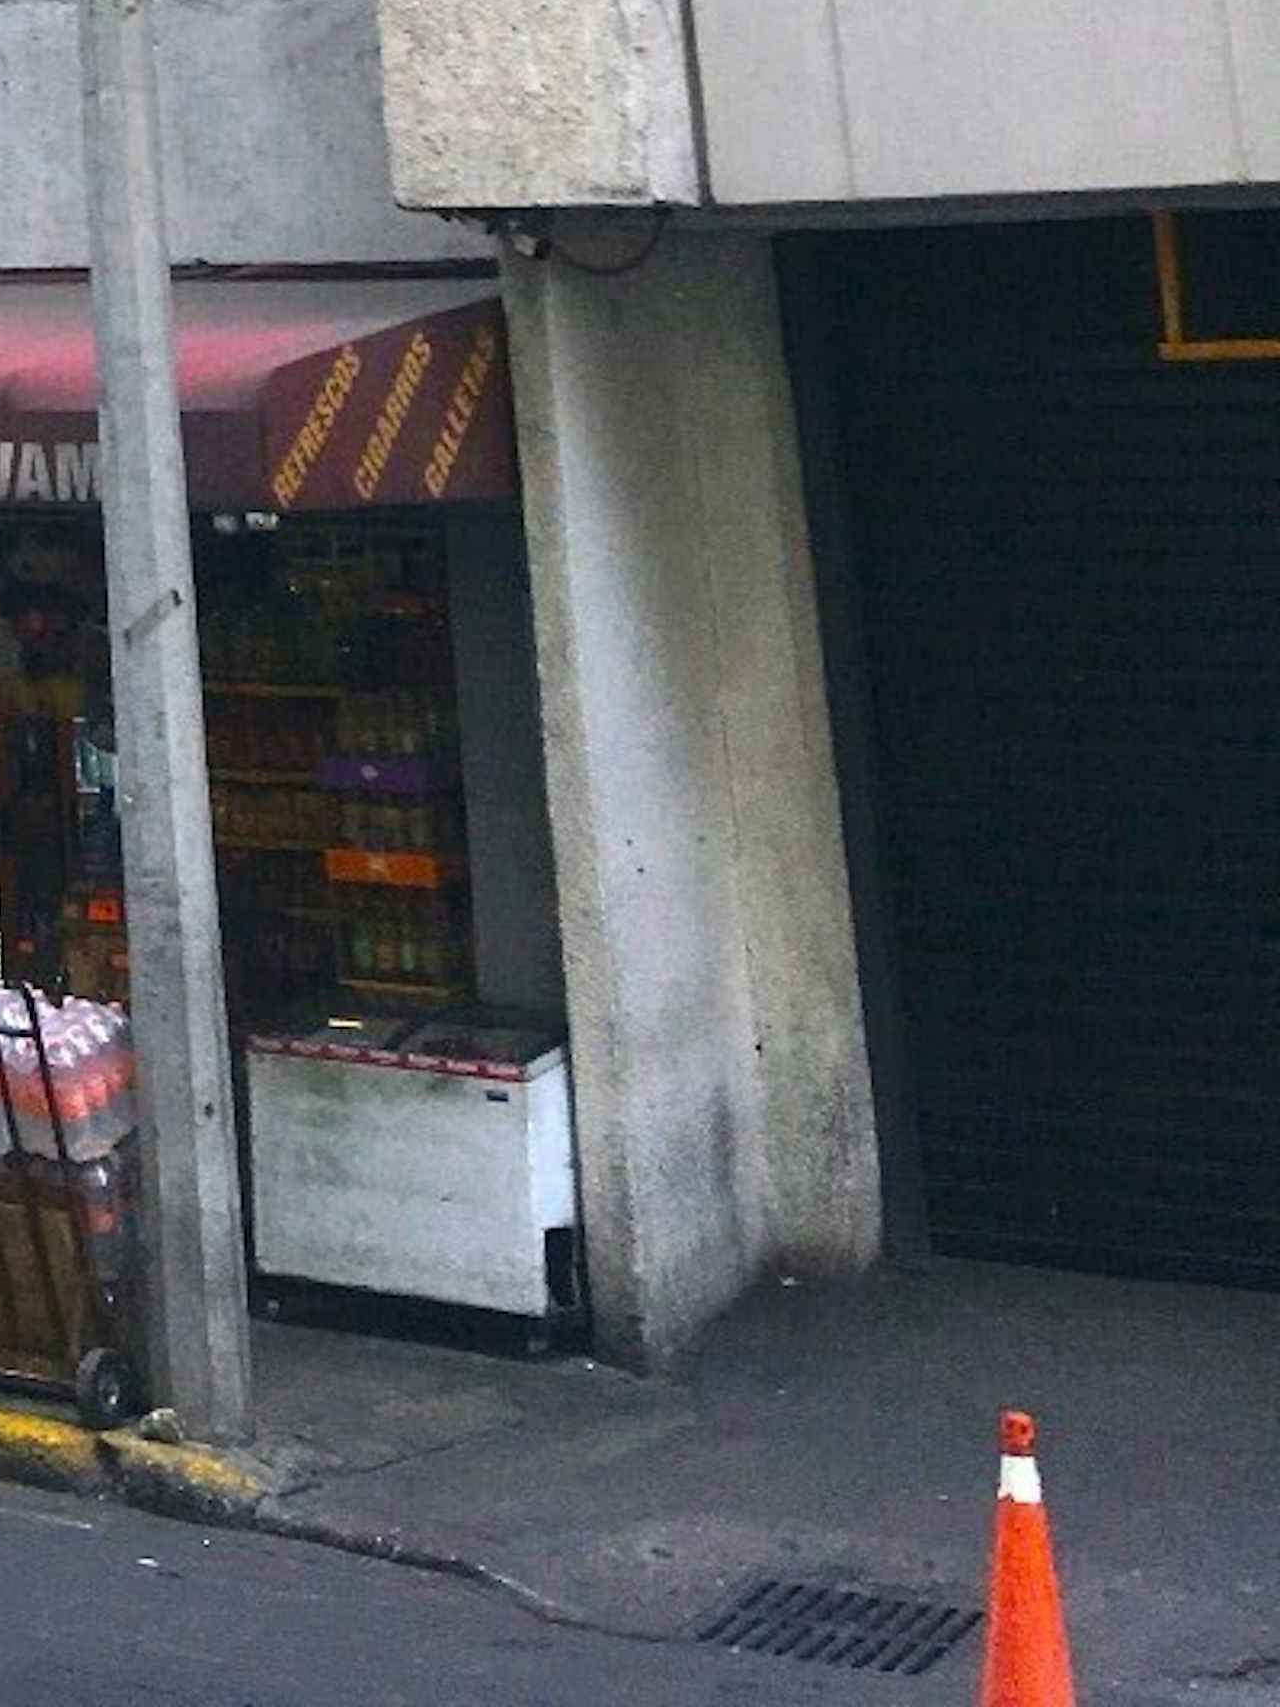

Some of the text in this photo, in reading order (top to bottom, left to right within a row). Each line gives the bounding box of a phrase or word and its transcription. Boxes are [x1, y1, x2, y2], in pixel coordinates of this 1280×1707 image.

[272, 344, 361, 508] REFRESCOS
[354, 332, 431, 500] CIGARROS
[424, 326, 494, 498] GALLETAS
